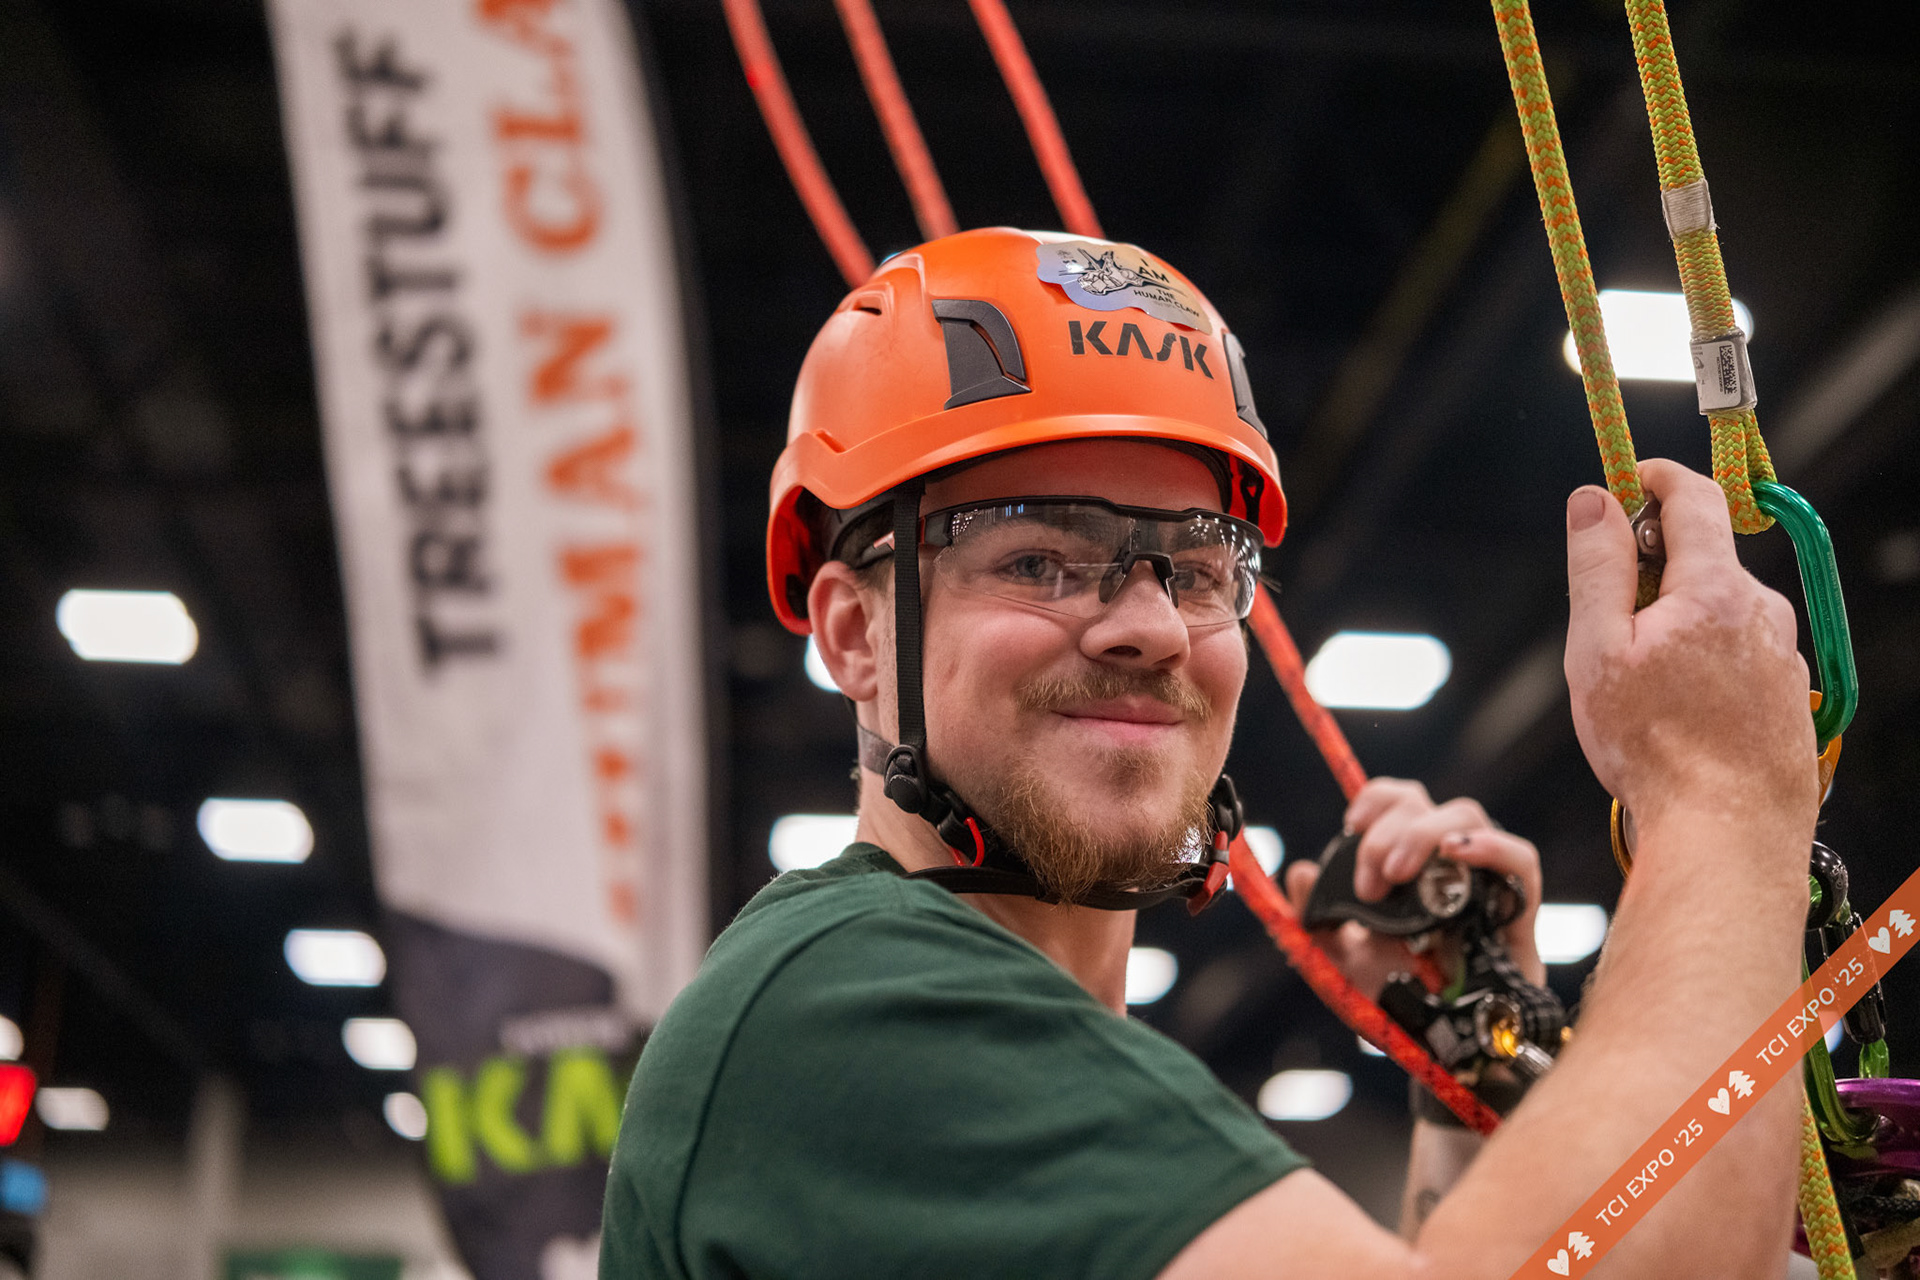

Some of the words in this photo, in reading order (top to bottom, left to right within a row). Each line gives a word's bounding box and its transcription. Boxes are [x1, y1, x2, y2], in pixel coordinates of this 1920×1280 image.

[1139, 266, 1170, 283] AM
[1133, 289, 1172, 303] HUMAN
[1174, 301, 1200, 318] CLAW
[1156, 288, 1176, 300] THE
[332, 32, 503, 682] TREESTUFF
[1068, 320, 1214, 380] KASK
